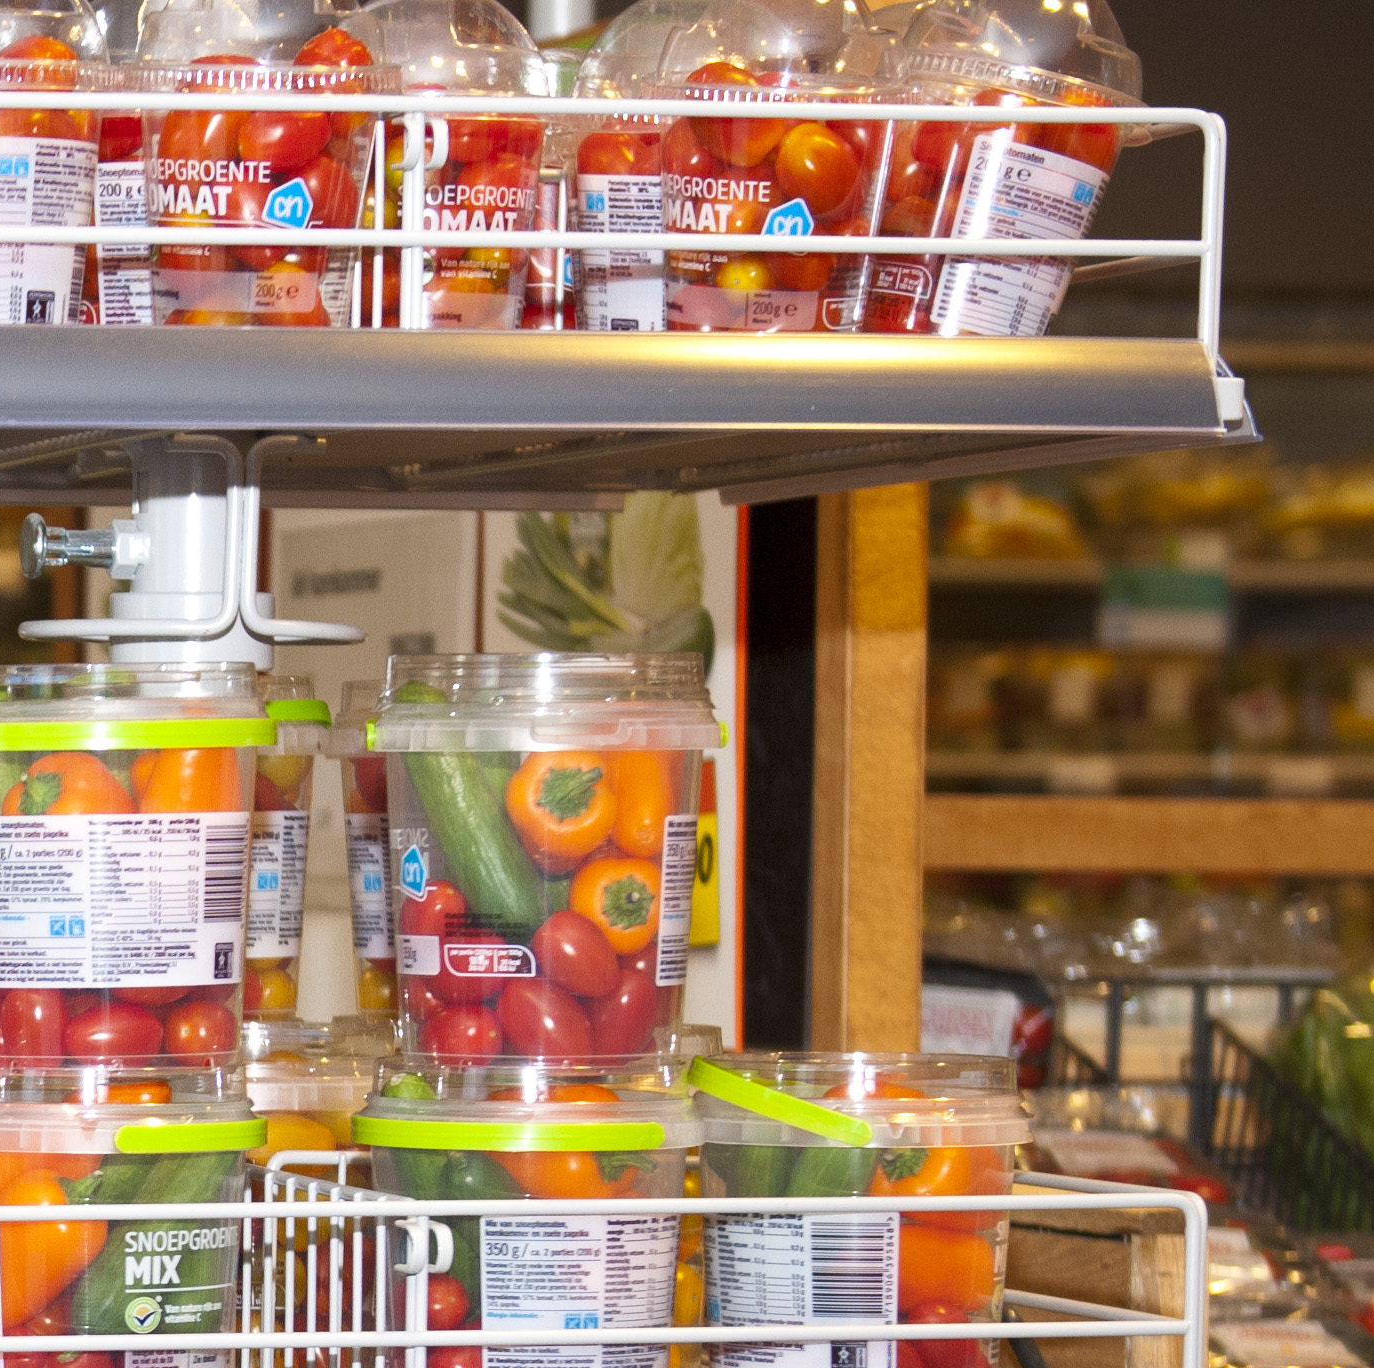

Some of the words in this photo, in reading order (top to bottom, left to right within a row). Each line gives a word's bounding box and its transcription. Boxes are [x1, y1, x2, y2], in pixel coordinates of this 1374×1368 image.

[99, 182, 122, 198] 200
[486, 1242, 509, 1256] 350
[125, 1254, 182, 1286] MIX
